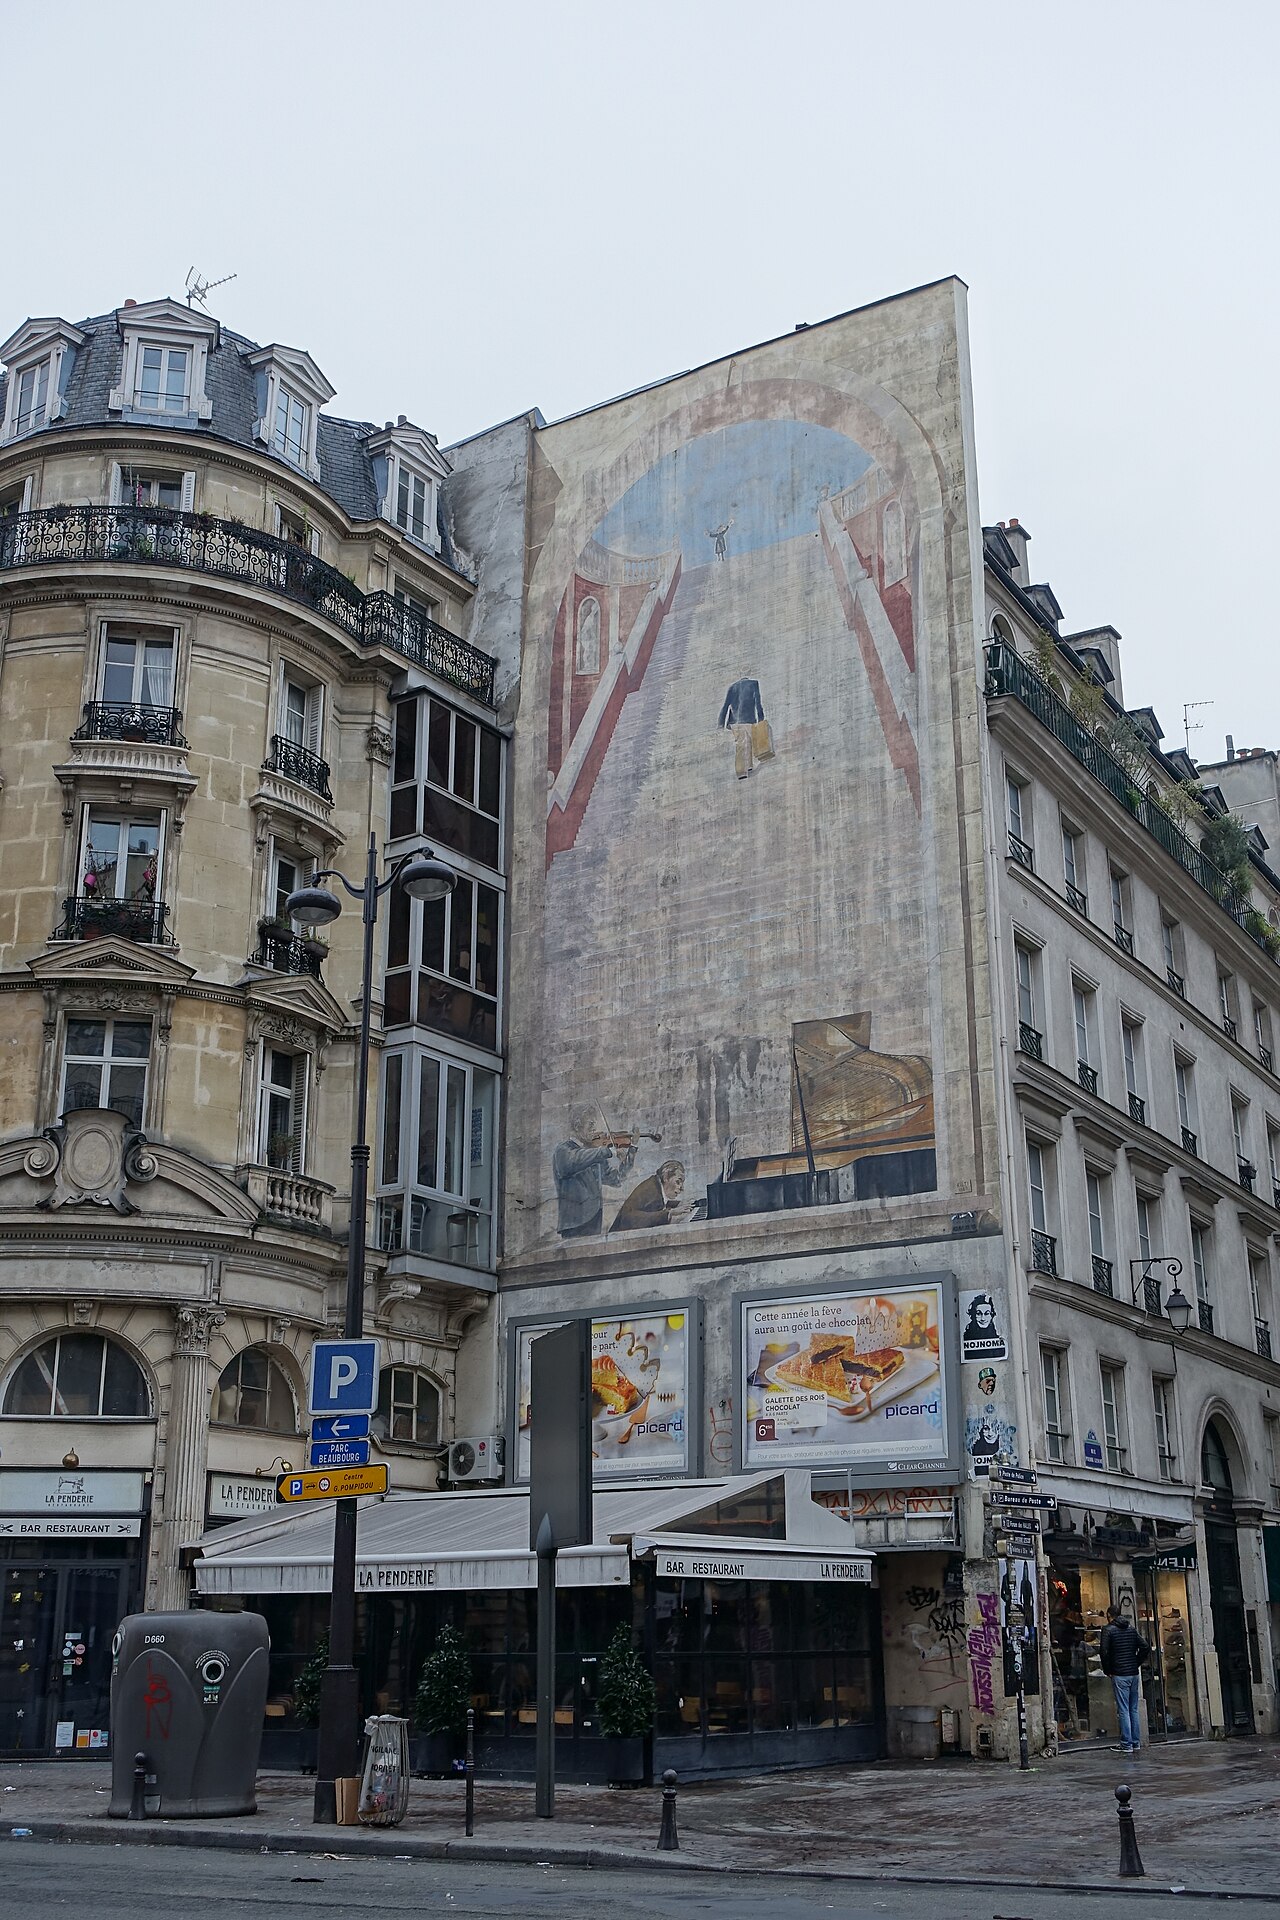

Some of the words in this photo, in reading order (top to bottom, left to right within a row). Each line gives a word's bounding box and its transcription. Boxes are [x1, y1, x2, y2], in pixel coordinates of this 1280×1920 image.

[754, 1312, 779, 1322] Cette
[781, 1308, 809, 1320] année
[811, 1307, 820, 1317] la
[822, 1305, 842, 1316] fève
[754, 1325, 775, 1335] aura
[777, 1325, 790, 1333] un
[791, 1321, 813, 1334] goût
[814, 1319, 827, 1329] de
[598, 1341, 619, 1353] part.
[963, 1339, 1005, 1349] NOJNOMA
[329, 1355, 358, 1399] P
[765, 1396, 794, 1404] GALETTE
[810, 1393, 825, 1401] ROIS
[765, 1404, 800, 1412] CHOCOLAT
[886, 1401, 938, 1419] picard
[637, 1419, 683, 1436] picard
[330, 1443, 349, 1453] PARC
[318, 1453, 360, 1463] BEAUBOURG
[343, 1473, 364, 1481] Centre
[221, 1485, 233, 1499] LA
[236, 1486, 276, 1503] PENDERI
[292, 1481, 301, 1495] P
[45, 1495, 55, 1503] LA
[57, 1495, 94, 1503] PENDERIE
[20, 1525, 41, 1533] BAR
[46, 1525, 111, 1533] RESTAURANT
[666, 1561, 684, 1573] BAR
[692, 1562, 745, 1576] RESTAURANT
[820, 1563, 831, 1577] LA
[832, 1564, 865, 1578] PENDERIE
[359, 1571, 373, 1586] LA
[378, 1569, 434, 1586] PENDERIE
[144, 1635, 165, 1644] D660
